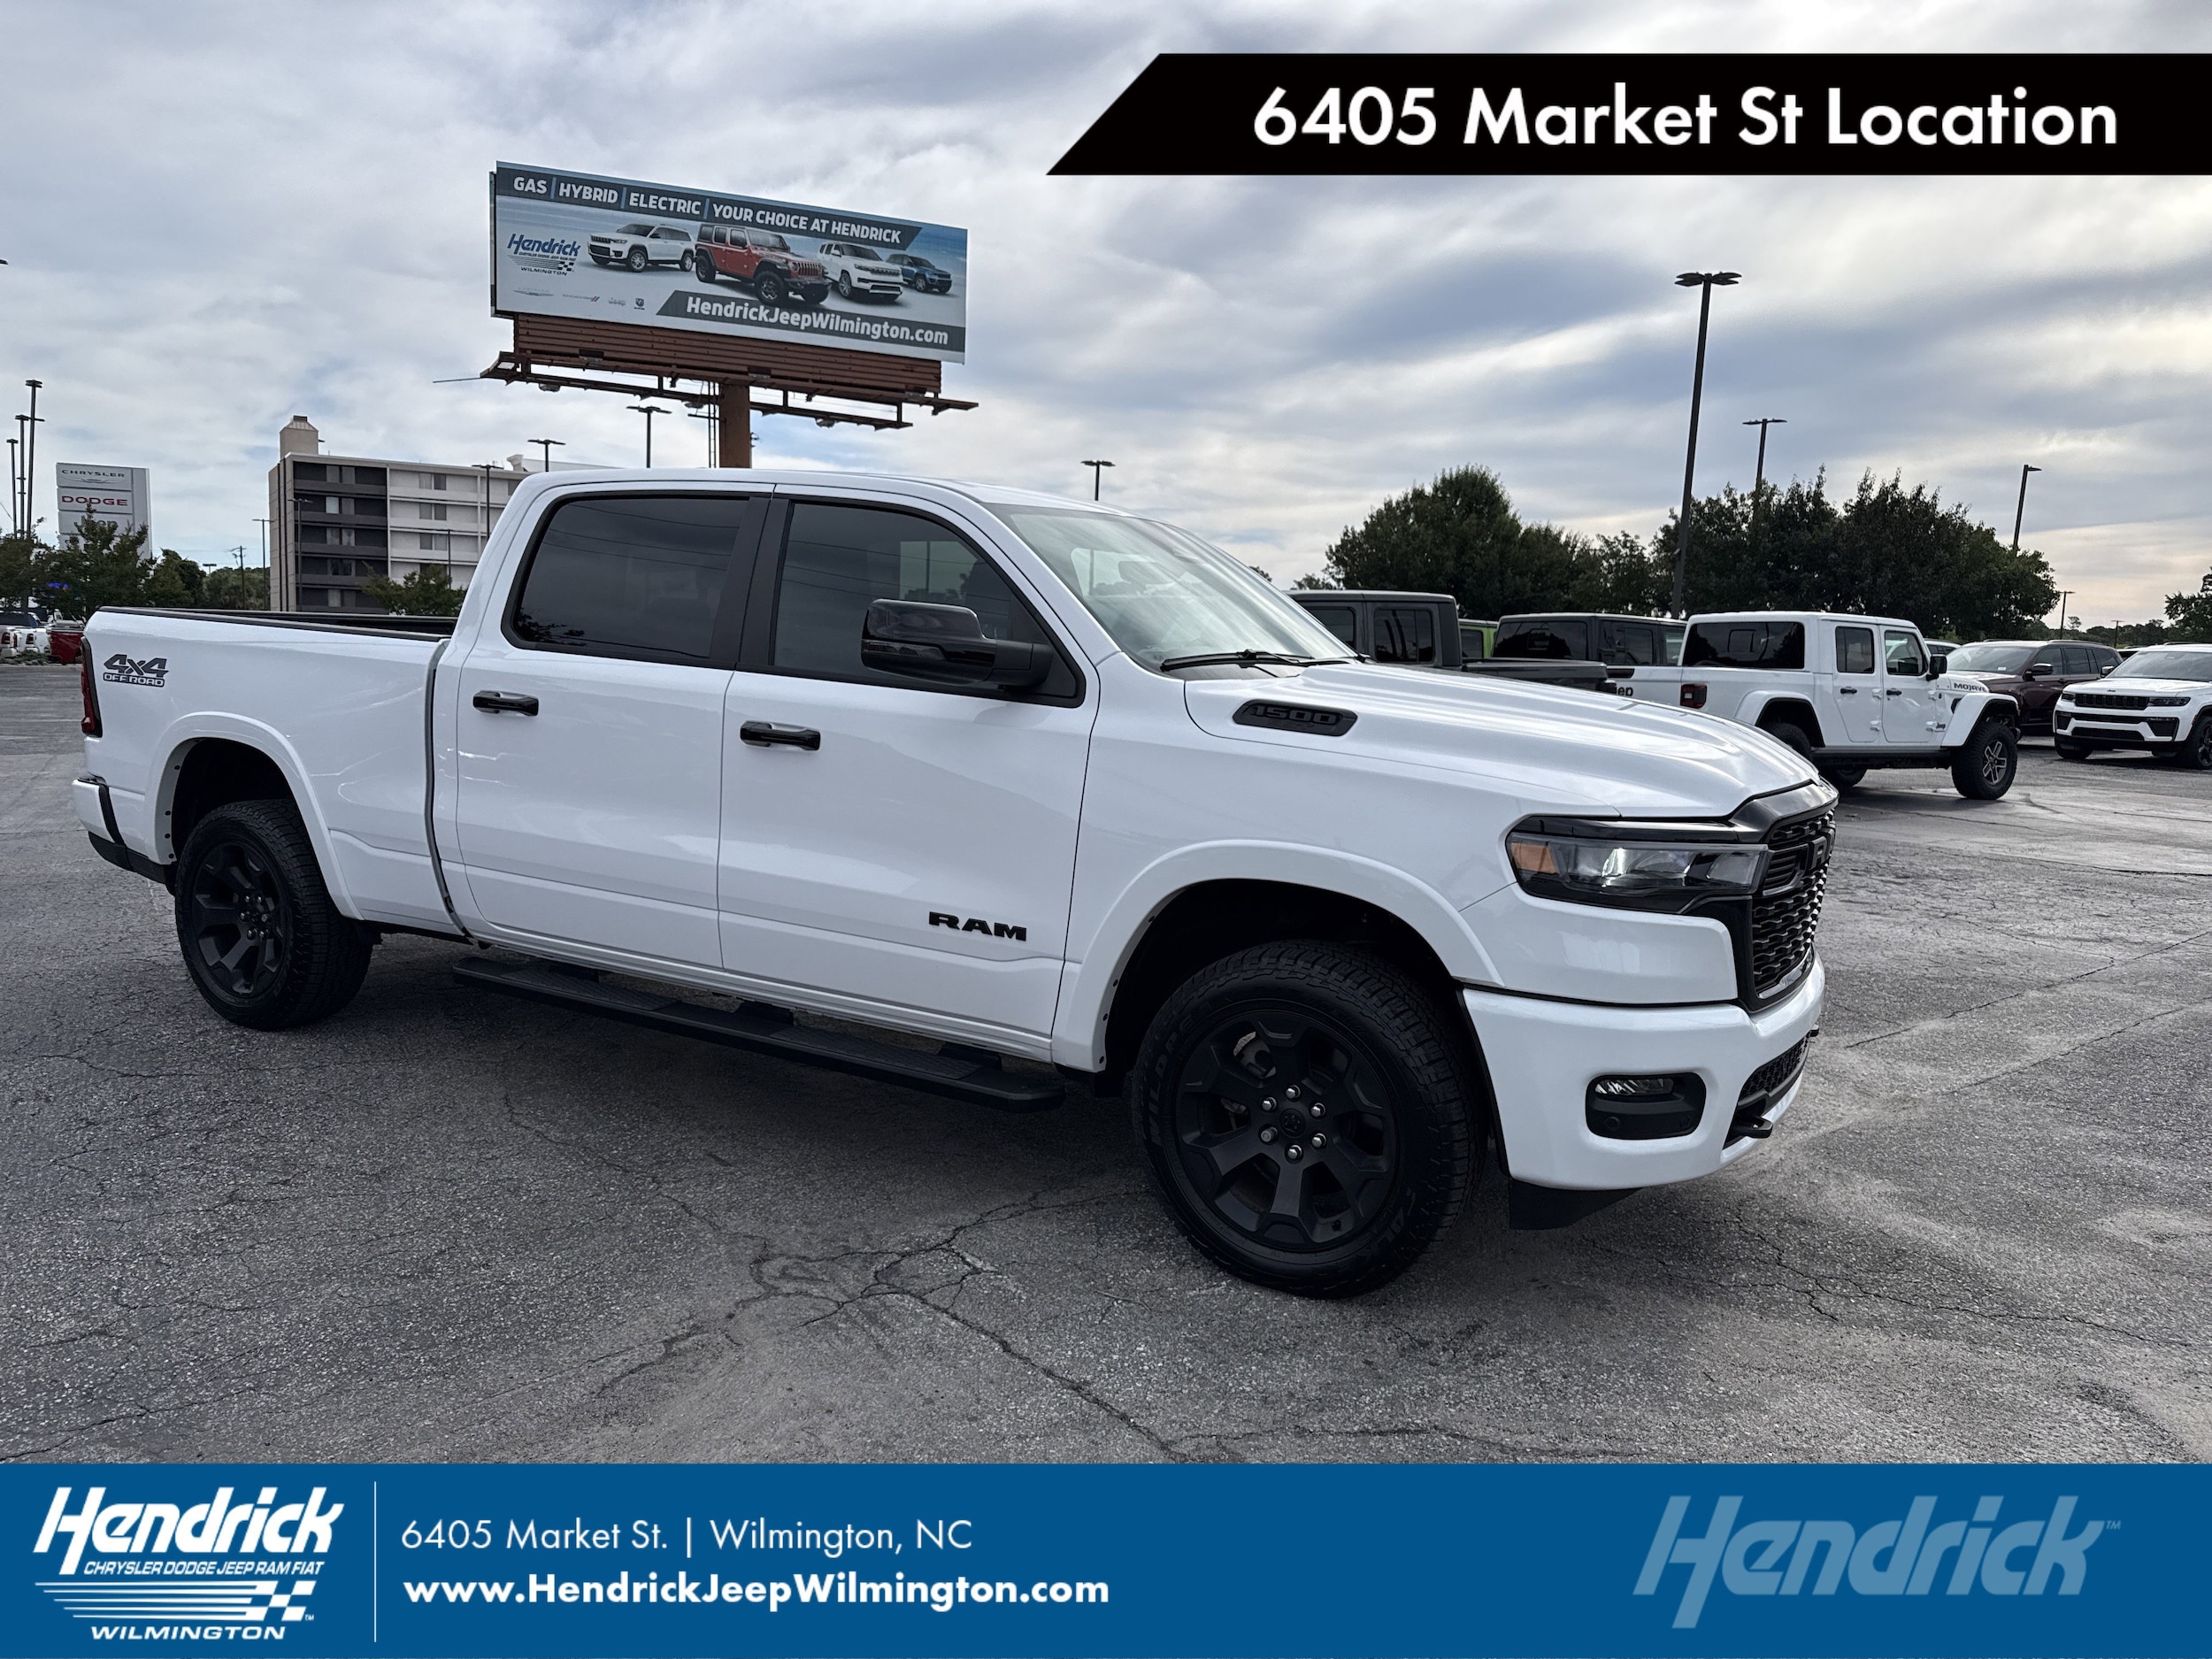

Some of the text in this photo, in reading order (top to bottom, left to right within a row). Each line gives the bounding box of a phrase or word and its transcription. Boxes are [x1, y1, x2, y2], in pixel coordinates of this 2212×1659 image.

[514, 176, 902, 244] GAS HYBRID ELECTRIC YOUR CHOICE AT HENDRICK
[507, 234, 580, 257] Hendrick
[520, 266, 568, 276] WILMINGTON
[687, 296, 949, 345] HendrickJeepWilmington.com
[61, 469, 126, 478] CHRYSLER
[61, 495, 128, 506] DODGE
[1246, 704, 1339, 726] 1500
[929, 911, 1027, 941] RAM
